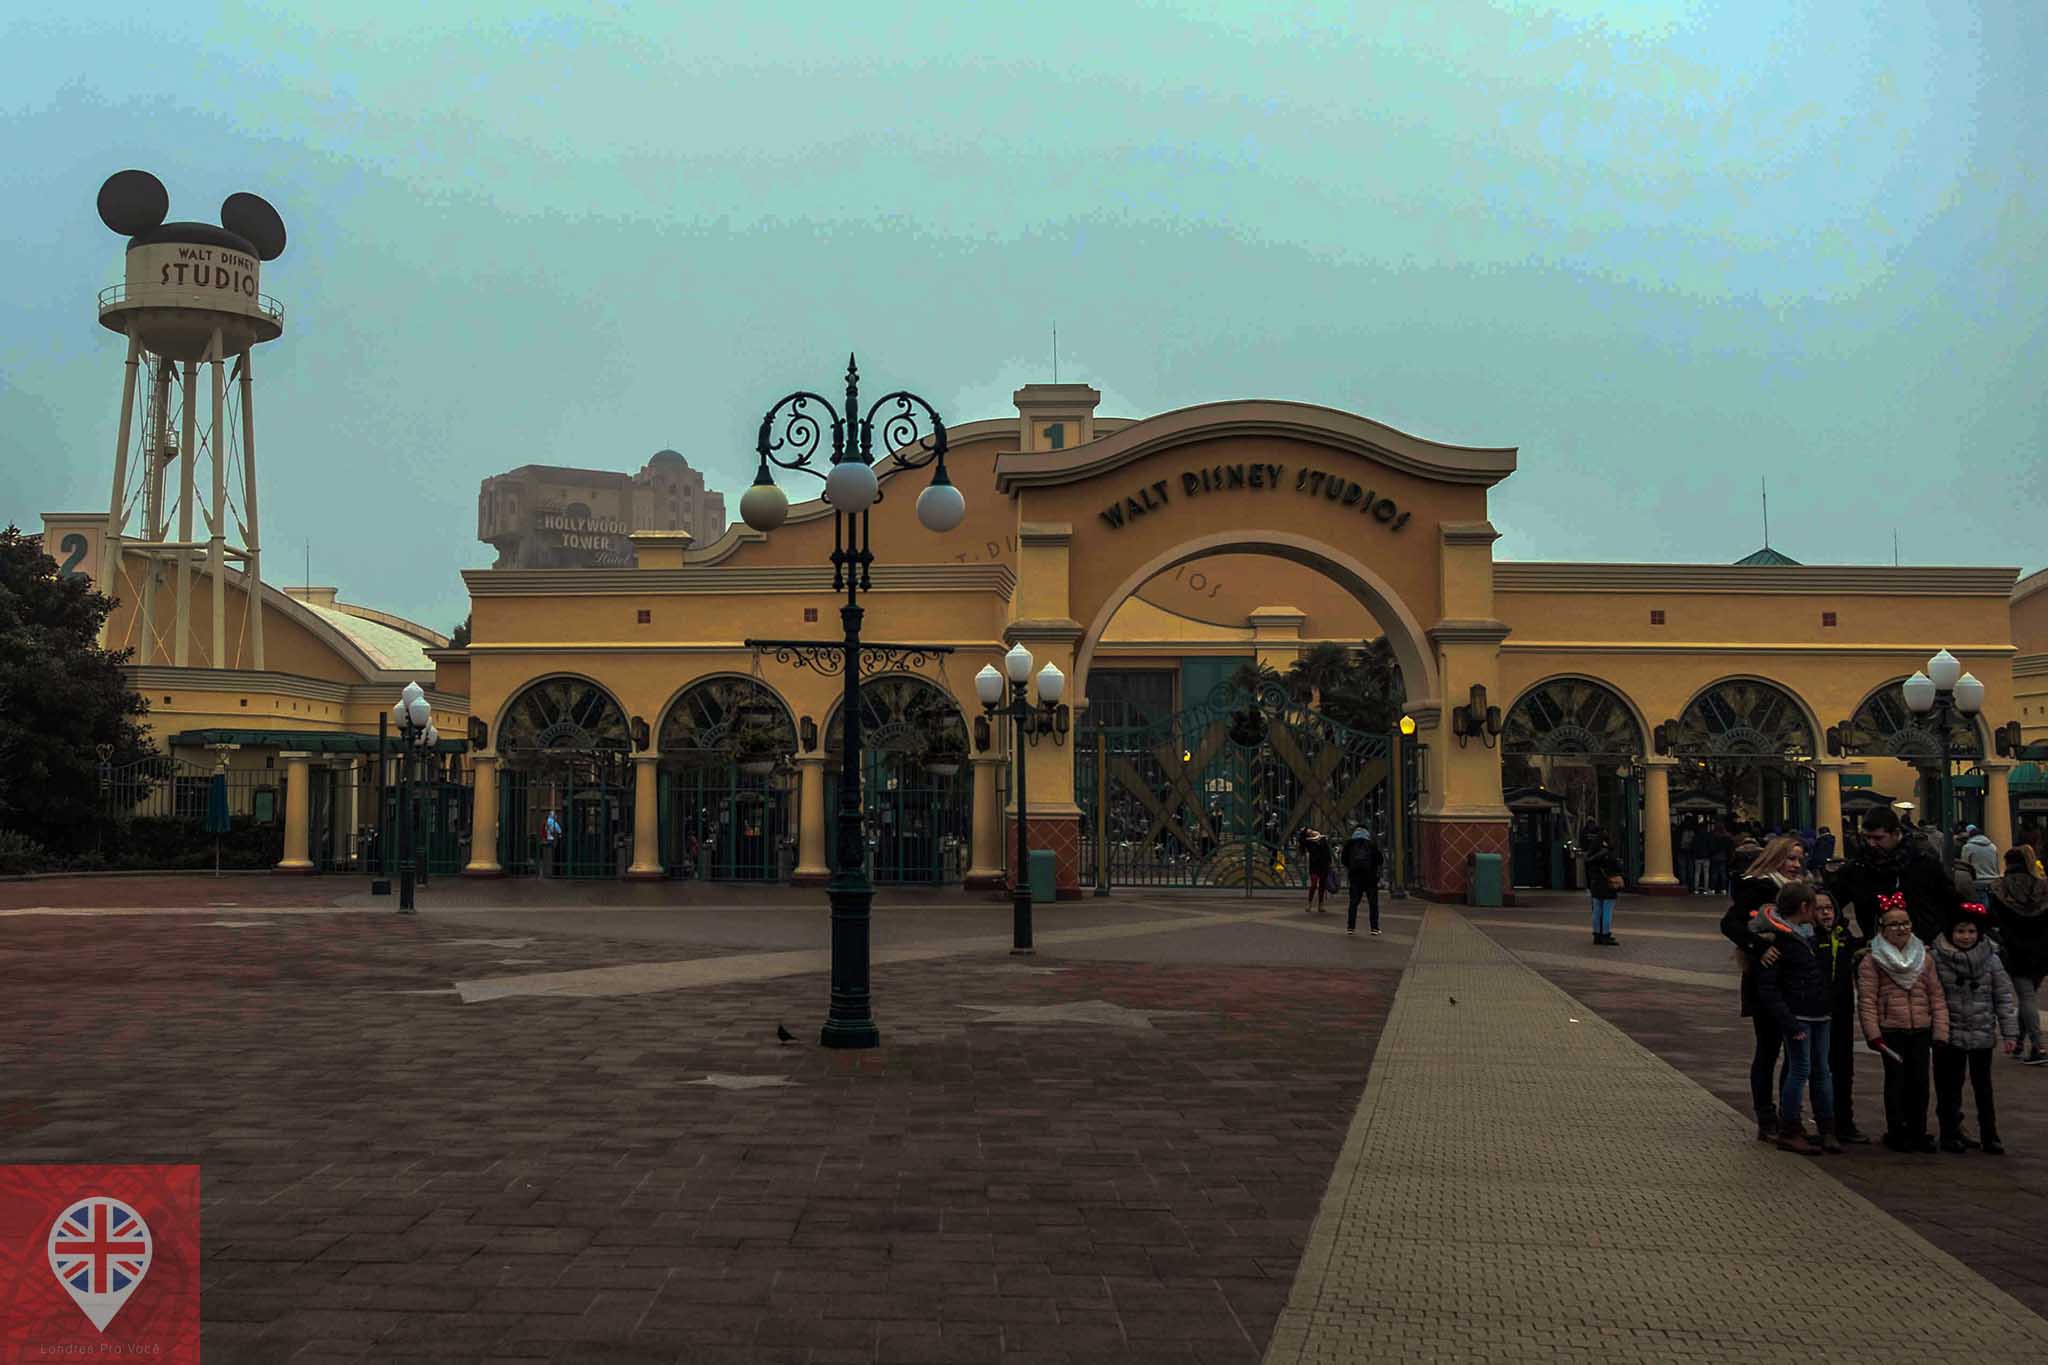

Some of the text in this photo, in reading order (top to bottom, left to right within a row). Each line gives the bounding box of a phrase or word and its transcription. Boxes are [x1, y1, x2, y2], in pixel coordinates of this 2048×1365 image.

[178, 247, 254, 272] WALT DISNEY
[161, 262, 259, 297] STUDIO
[1043, 423, 1064, 449] 1
[1097, 463, 1411, 532] WALT DISNEY STUDIOS
[544, 513, 627, 534] HOLLYWOOD
[561, 533, 609, 551] TOWER
[61, 533, 88, 586] 2
